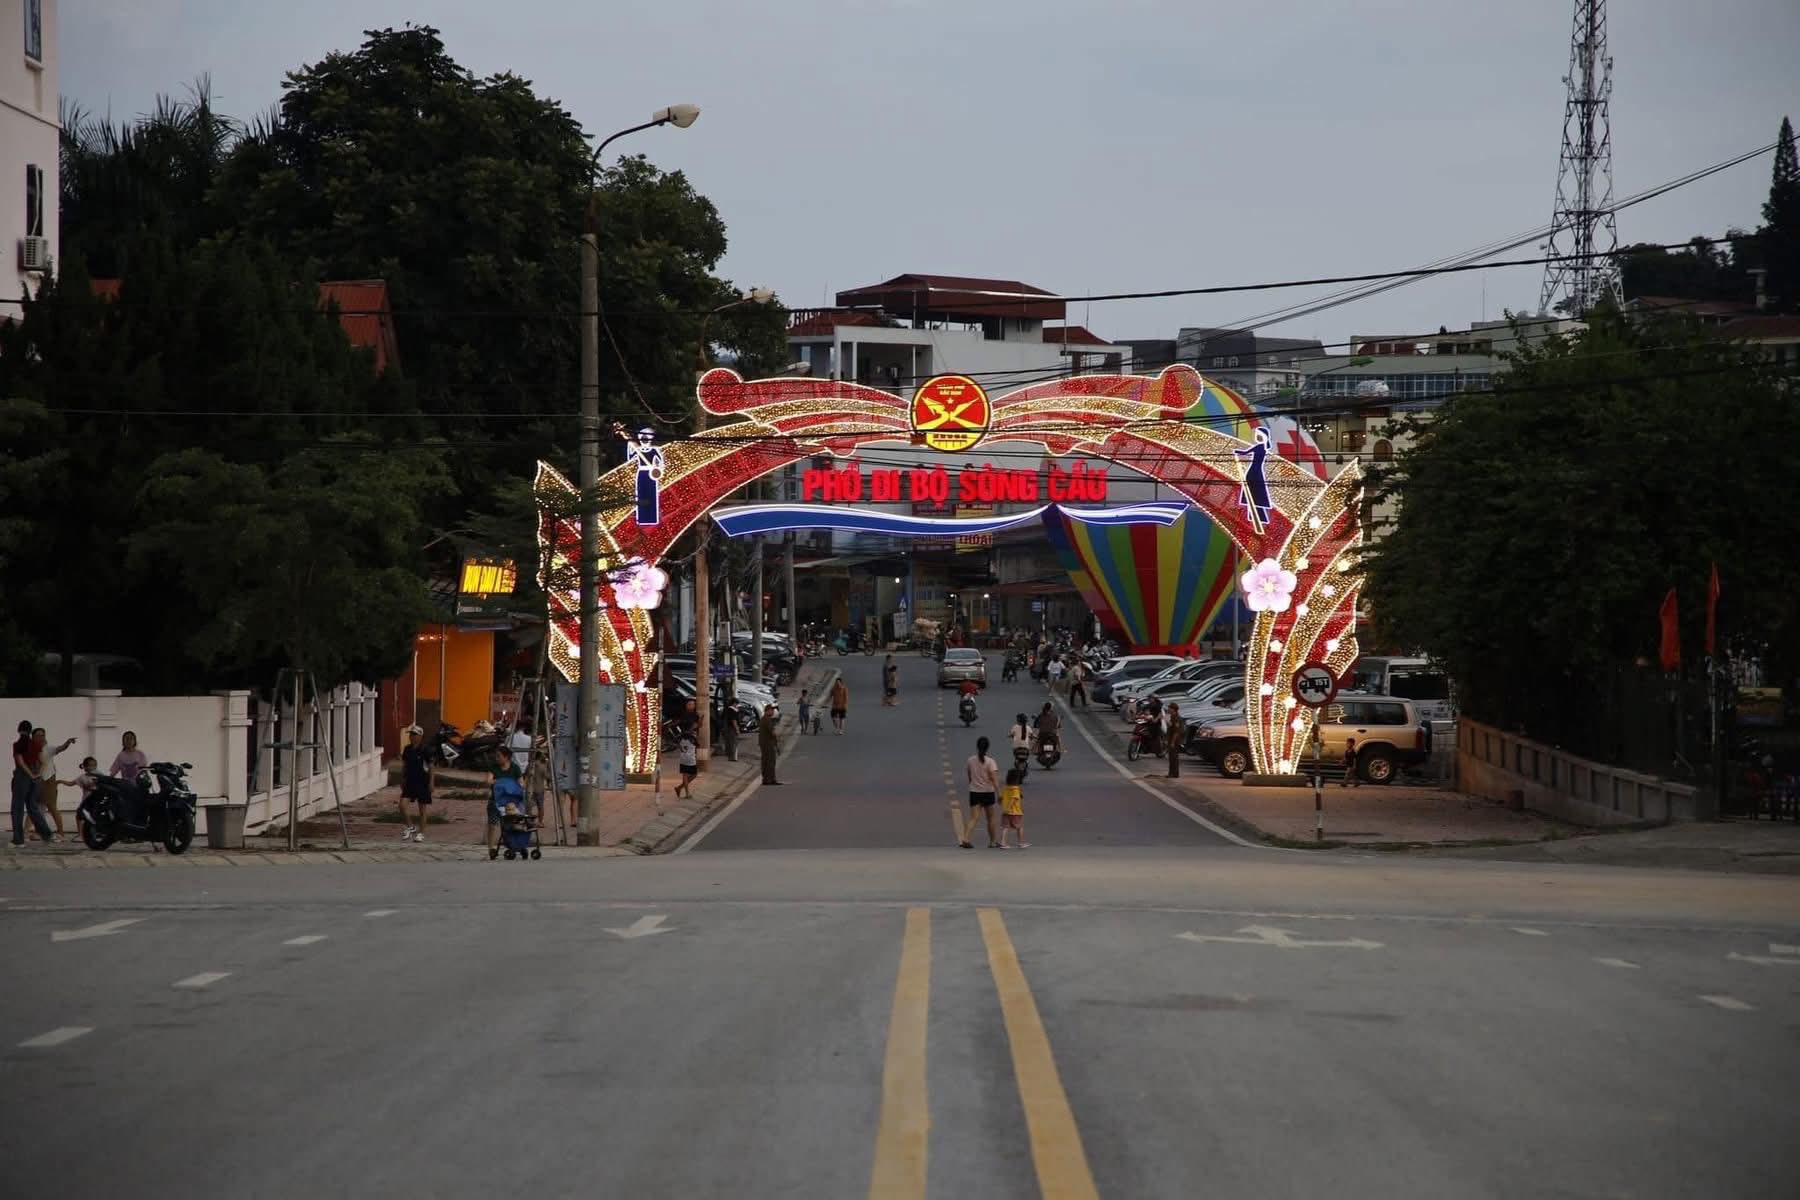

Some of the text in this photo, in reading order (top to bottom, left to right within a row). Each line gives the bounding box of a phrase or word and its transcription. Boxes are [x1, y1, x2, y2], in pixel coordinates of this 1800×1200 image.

[803, 457, 862, 502] PHỐ
[910, 463, 949, 510] BỘ
[959, 462, 1039, 502] SÔNG
